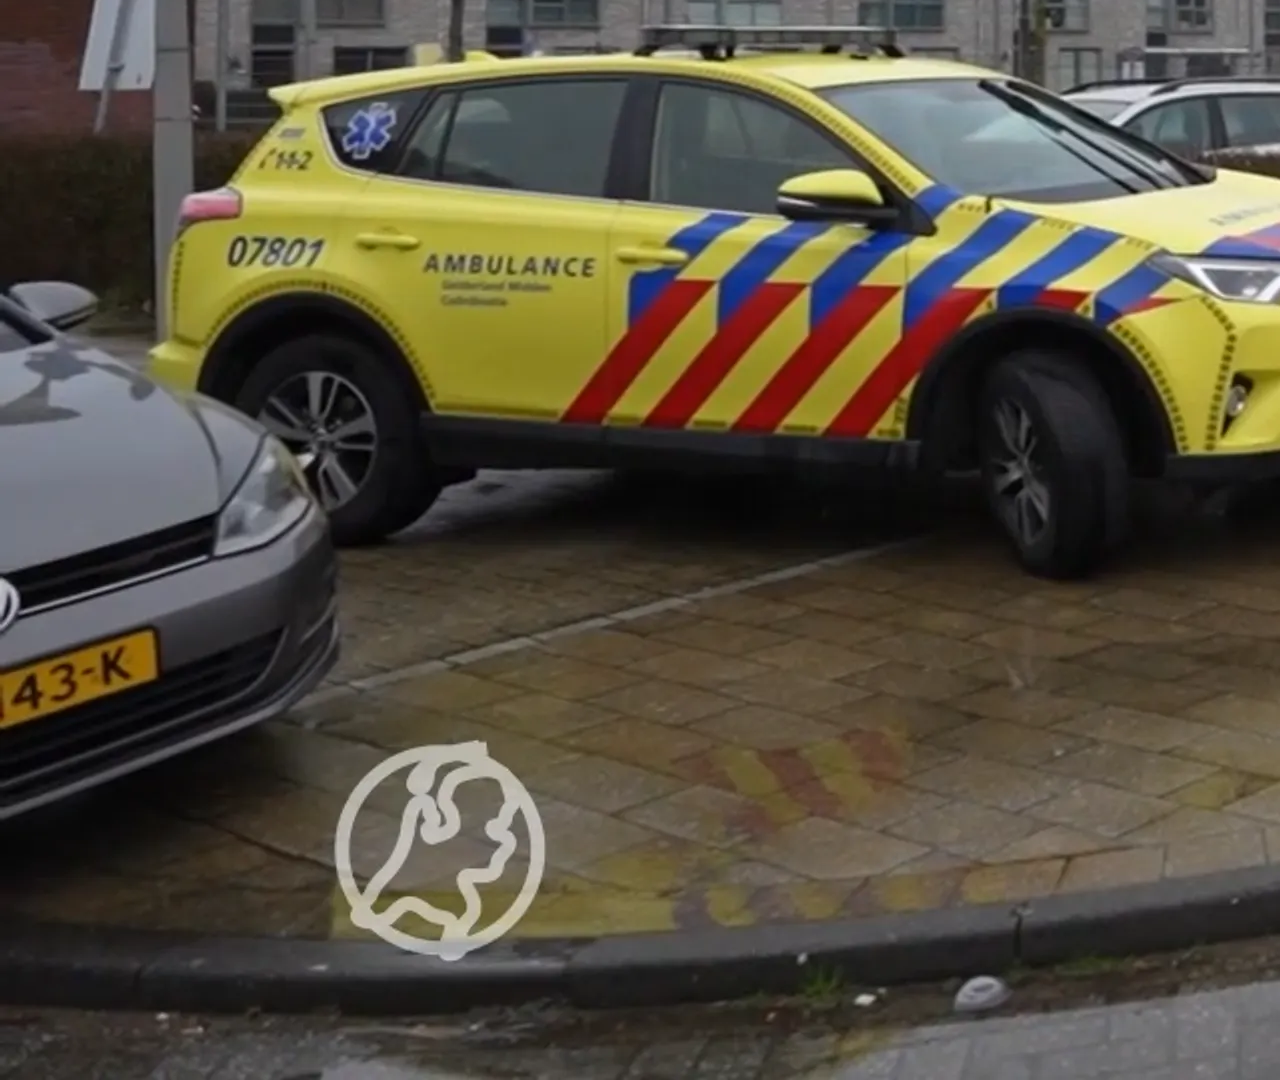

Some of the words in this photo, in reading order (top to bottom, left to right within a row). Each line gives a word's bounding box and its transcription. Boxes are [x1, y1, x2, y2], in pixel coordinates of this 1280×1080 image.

[227, 235, 325, 267] 07801
[423, 253, 597, 278] AMBULANCE
[0, 646, 131, 719] 43-K
